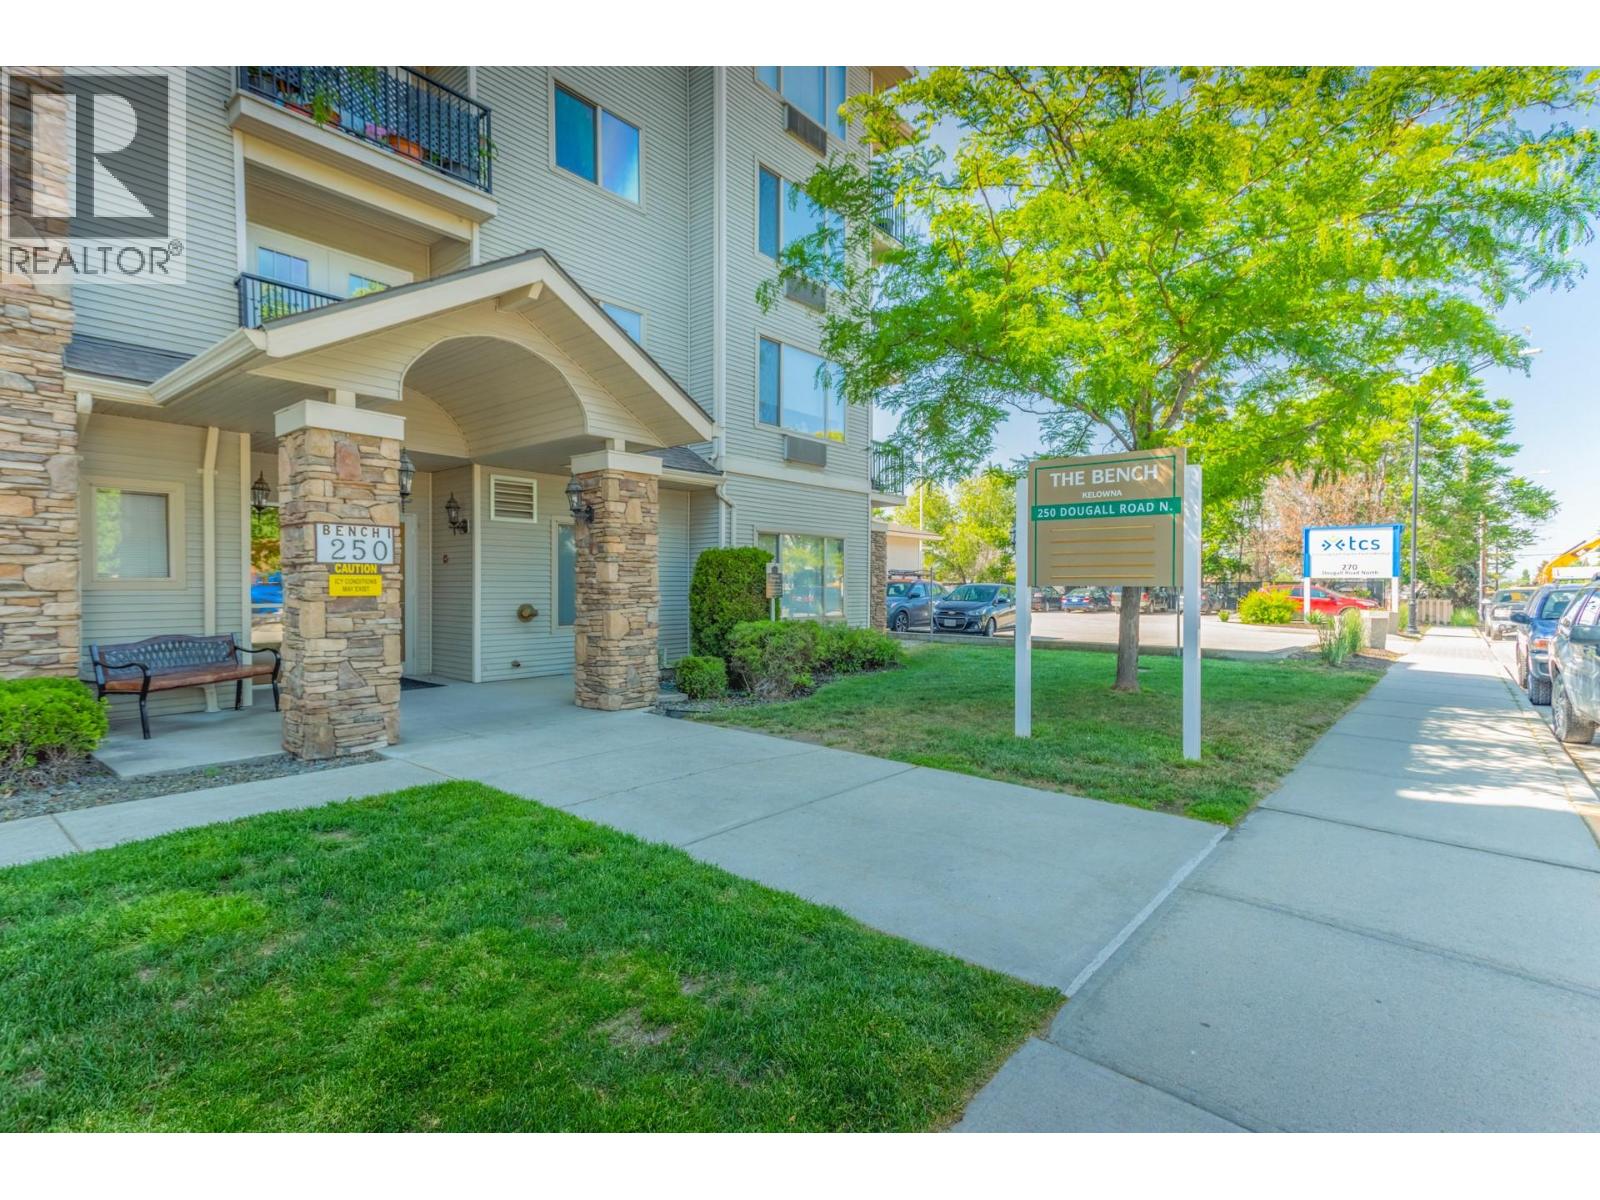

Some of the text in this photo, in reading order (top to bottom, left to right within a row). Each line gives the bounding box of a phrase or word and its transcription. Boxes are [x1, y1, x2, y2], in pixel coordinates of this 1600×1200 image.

[1050, 464, 1158, 487] THE BENCH
[1082, 489, 1122, 499] KELOWNA
[1037, 501, 1173, 518] 250 DOUGALL ROAD N.
[322, 524, 380, 539] BENCH
[330, 538, 388, 562] 250
[1349, 536, 1380, 551] tcs
[335, 563, 378, 574] CAUTION
